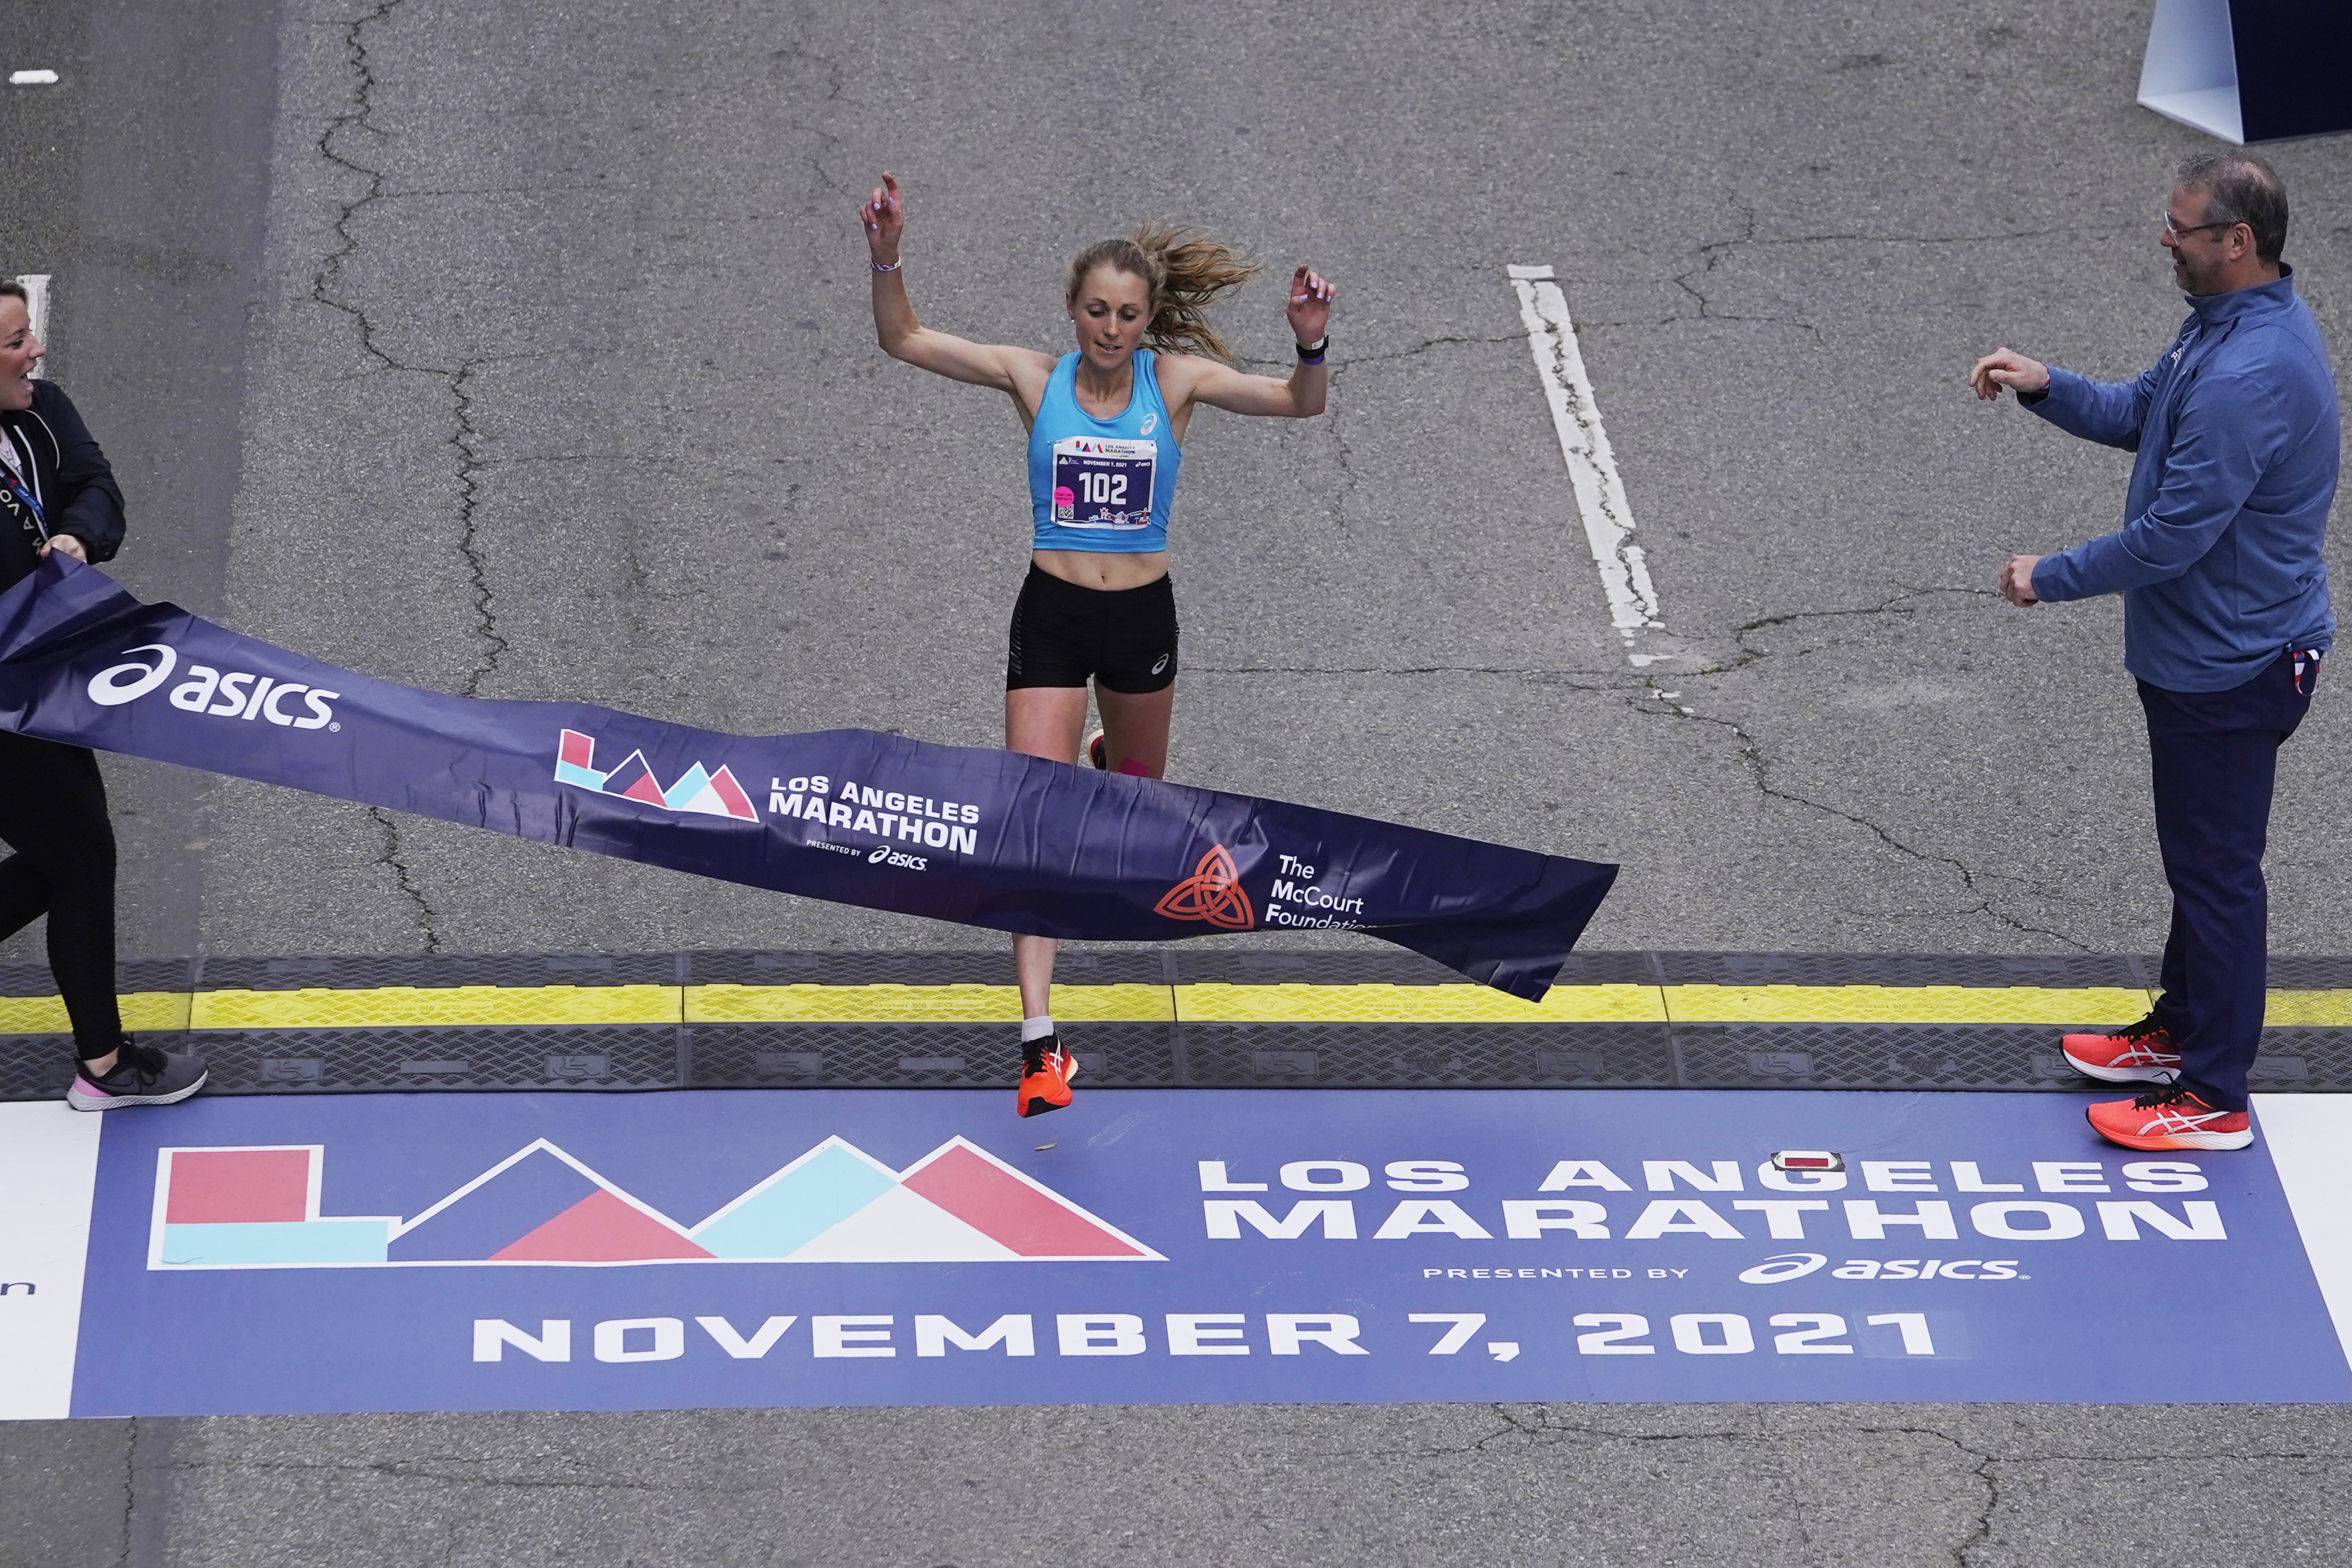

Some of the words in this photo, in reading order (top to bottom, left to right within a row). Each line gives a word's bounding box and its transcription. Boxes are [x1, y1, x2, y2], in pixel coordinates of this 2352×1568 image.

[1079, 472, 1128, 505] 102
[771, 775, 829, 794] LOS
[840, 781, 979, 824] ANGELES
[769, 792, 978, 855] MARATHON
[806, 839, 850, 854] PRESENTED
[1280, 854, 1314, 879] The
[1271, 879, 1364, 914] McCourt
[1199, 1160, 1469, 1192] LOS
[1537, 1160, 2209, 1193] ANGELES
[1203, 1199, 2228, 1240] MARATHON
[1423, 1268, 1632, 1279] PRESENTED
[1647, 1268, 1689, 1279] BY
[473, 1313, 1370, 1363] NOVEMBER
[1408, 1313, 1520, 1362] 7,
[1573, 1313, 1936, 1355] 2021
